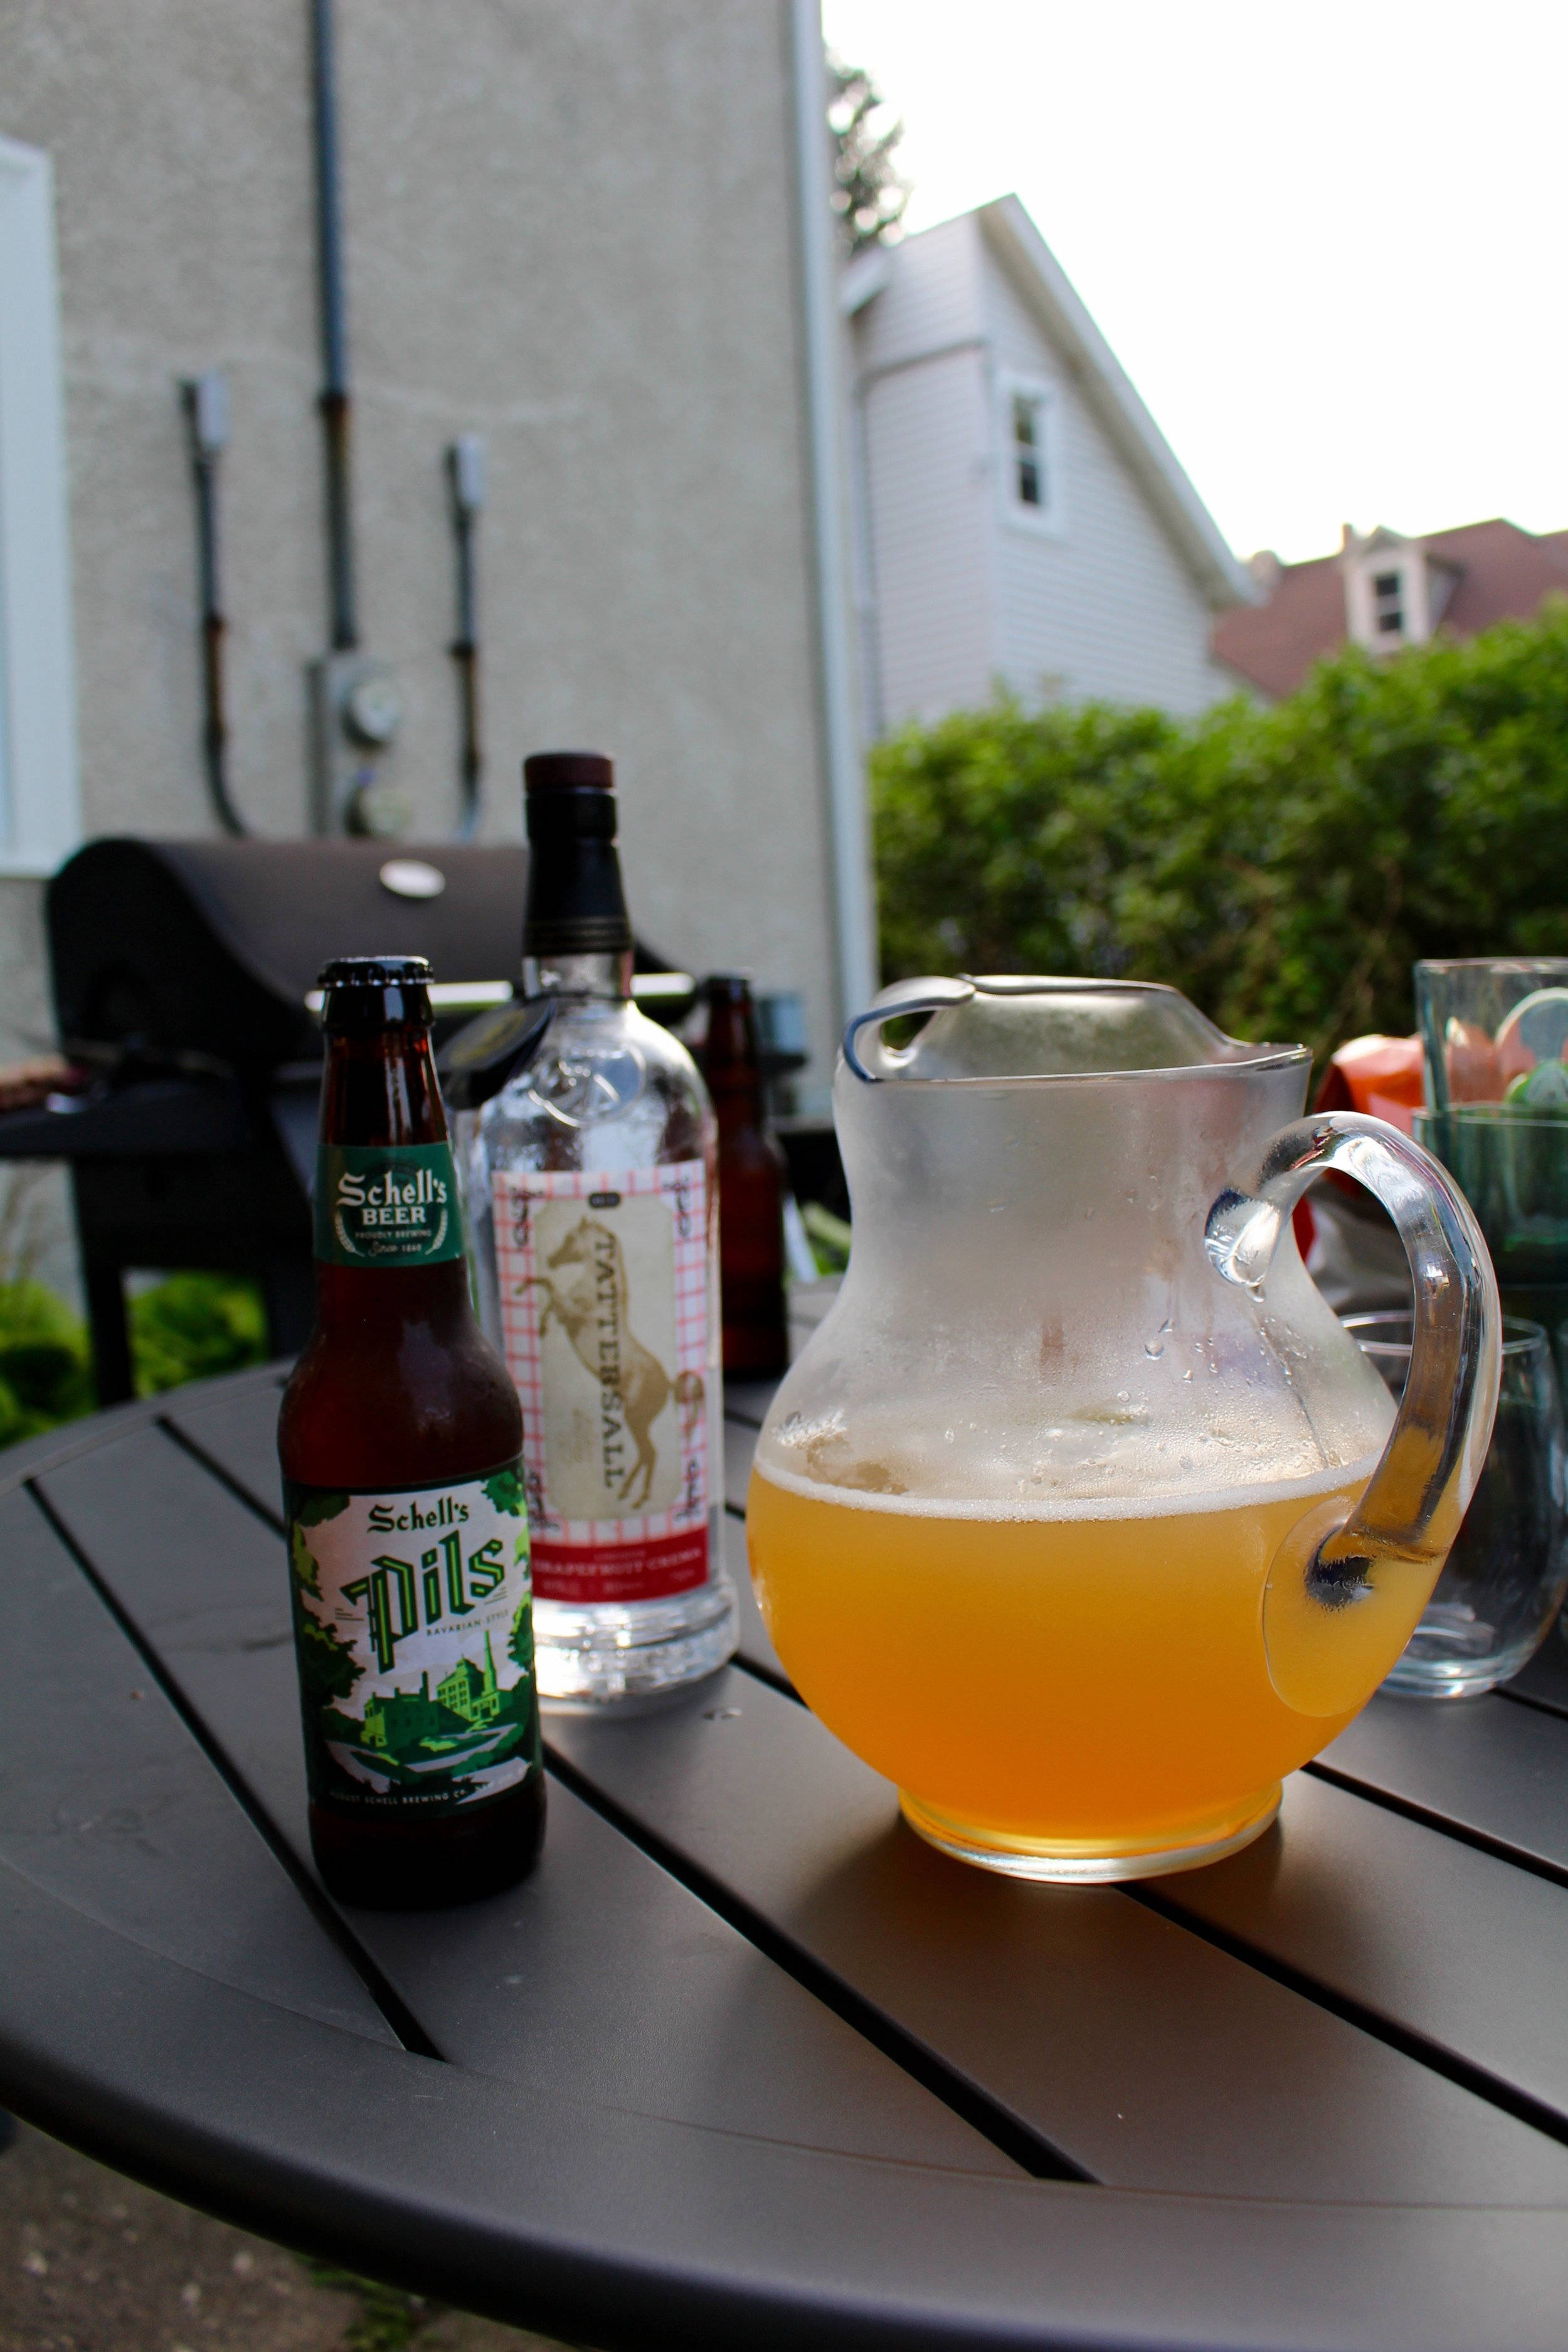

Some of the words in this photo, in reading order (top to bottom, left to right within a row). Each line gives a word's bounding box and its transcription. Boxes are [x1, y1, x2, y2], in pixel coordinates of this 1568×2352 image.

[336, 1168, 447, 1206] Schell's
[362, 1206, 426, 1226] BEER
[395, 1228, 432, 1239] BREWING
[595, 1236, 625, 1488] TATTERSALL
[367, 1496, 469, 1533] Schell's
[339, 1530, 505, 1675] Pils
[426, 1619, 481, 1636] BAVARIAN
[364, 1796, 398, 1805] SCHELL
[401, 1792, 450, 1804] BREWING
